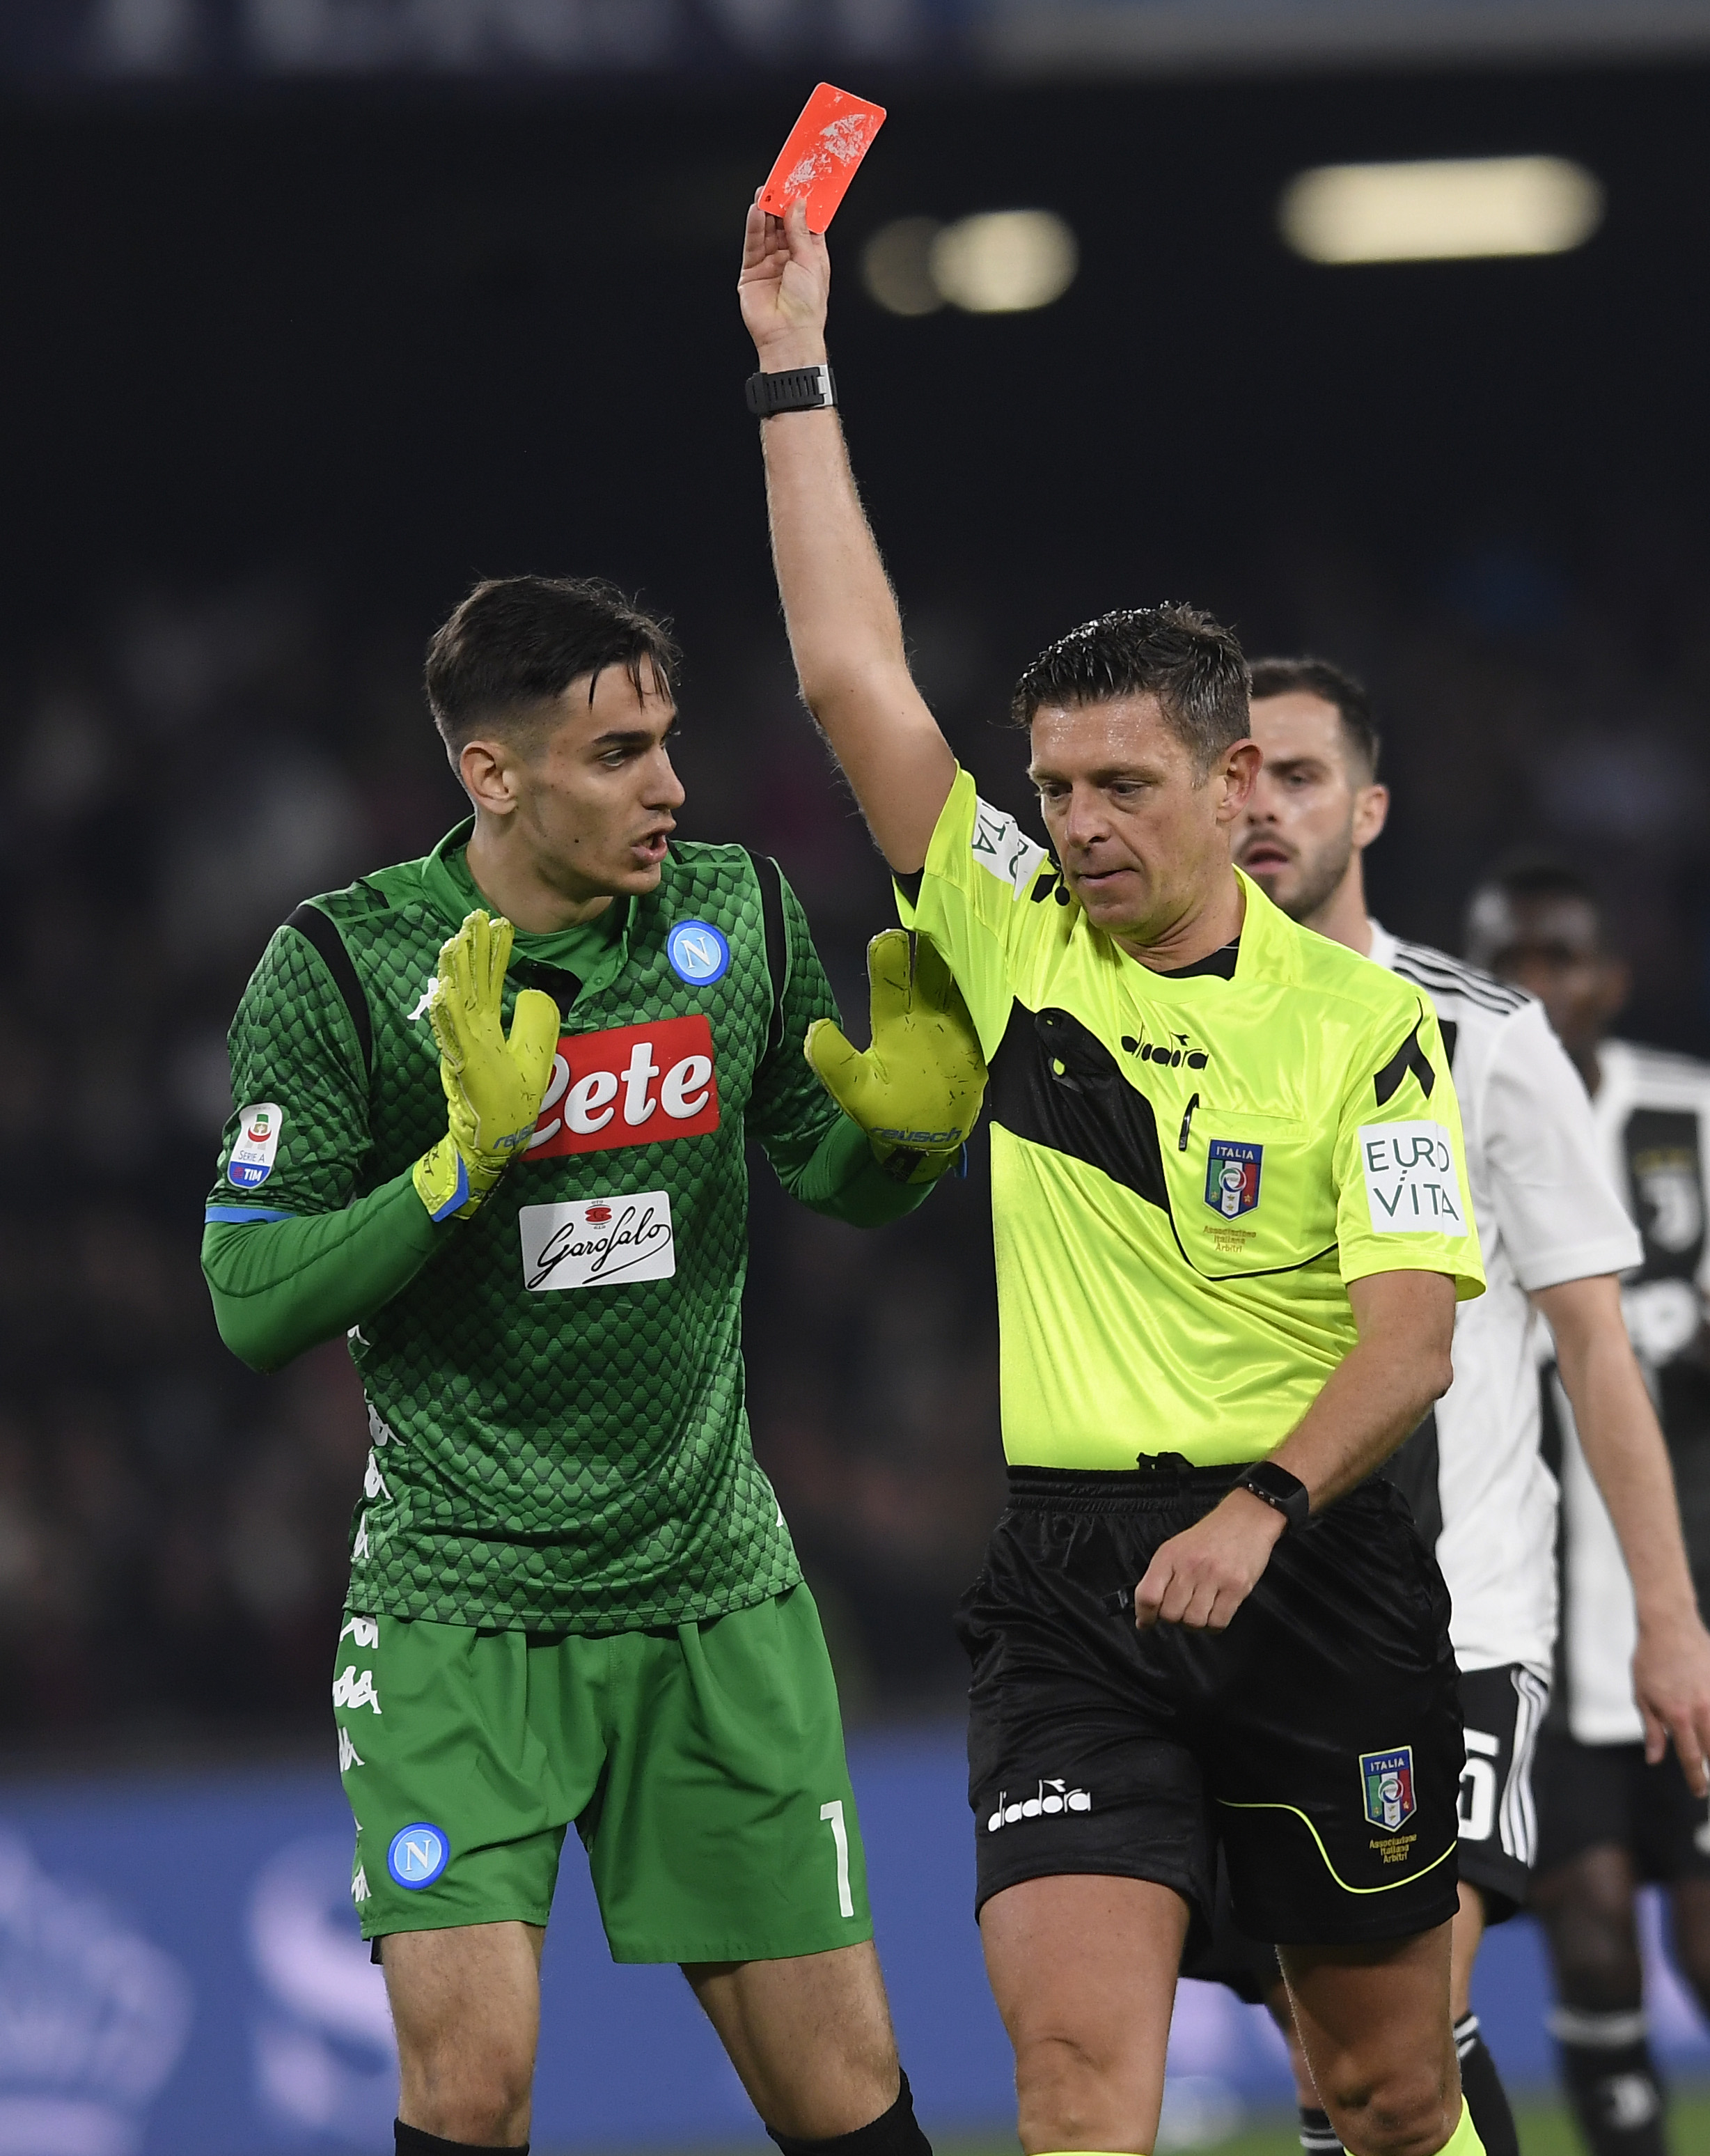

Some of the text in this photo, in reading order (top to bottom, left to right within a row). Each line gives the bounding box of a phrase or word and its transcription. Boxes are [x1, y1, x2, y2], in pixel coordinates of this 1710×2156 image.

[680, 936, 710, 969] N
[1121, 1022, 1209, 1070] diadora
[871, 1127, 962, 1143] reusch
[239, 1150, 265, 1163] SERIE A
[1216, 1146, 1253, 1159] ITALIA
[1366, 1137, 1450, 1173] EURO
[244, 1169, 262, 1181] TIM
[1372, 1183, 1460, 1221] VITA
[527, 1205, 671, 1289] Garofalo
[1370, 1758, 1404, 1772] ITALIA
[988, 1778, 1091, 1832] diadora
[405, 1839, 432, 1872] N
[819, 1799, 854, 1918] 1
